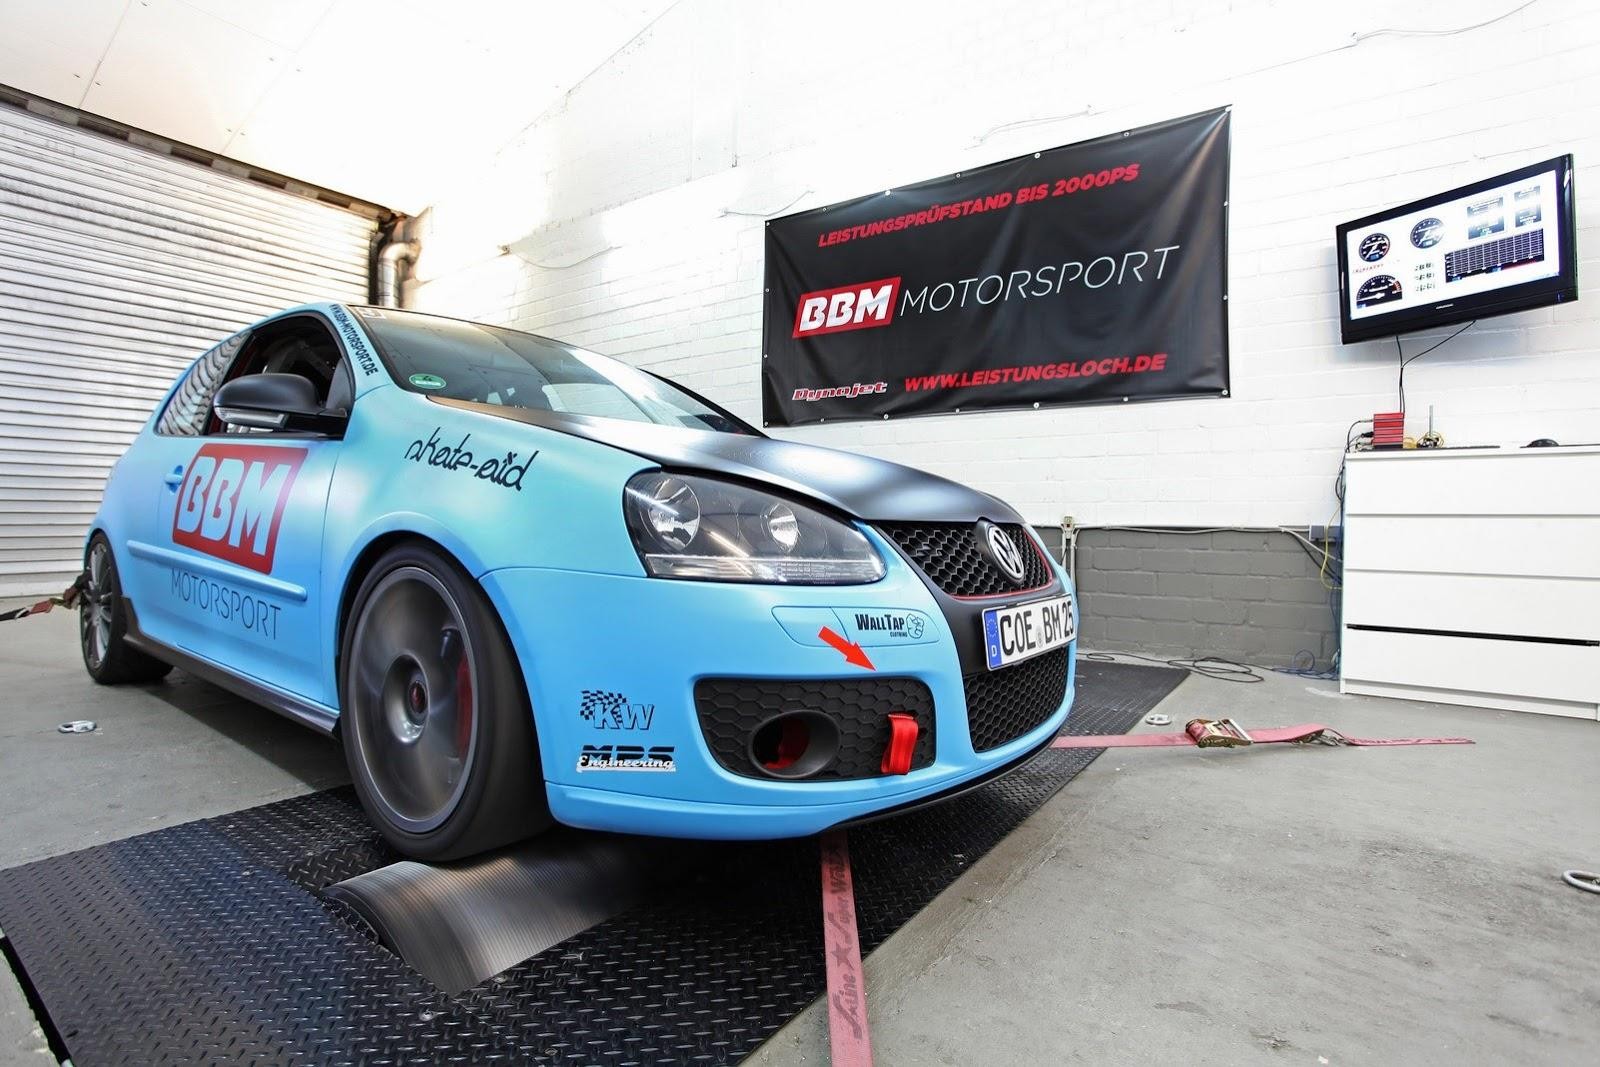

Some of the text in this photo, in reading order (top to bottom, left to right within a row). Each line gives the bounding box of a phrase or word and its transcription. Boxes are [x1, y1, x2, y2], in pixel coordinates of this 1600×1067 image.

[817, 163, 1142, 248] LEISTUNGSPRÜFSTAND BIS 2000PS
[798, 245, 1181, 333] BBM MOTORSPORT
[791, 381, 888, 402] Dynojet
[905, 353, 1168, 393] WWW.LEISTUNGSLOCH.DE
[177, 455, 294, 556] BBM
[171, 569, 282, 640] MOTORSPORT
[992, 645, 997, 657] D
[1000, 610, 1036, 656] COE
[1042, 603, 1062, 643] BM
[593, 703, 655, 731] KW
[577, 755, 675, 773] Engineering
